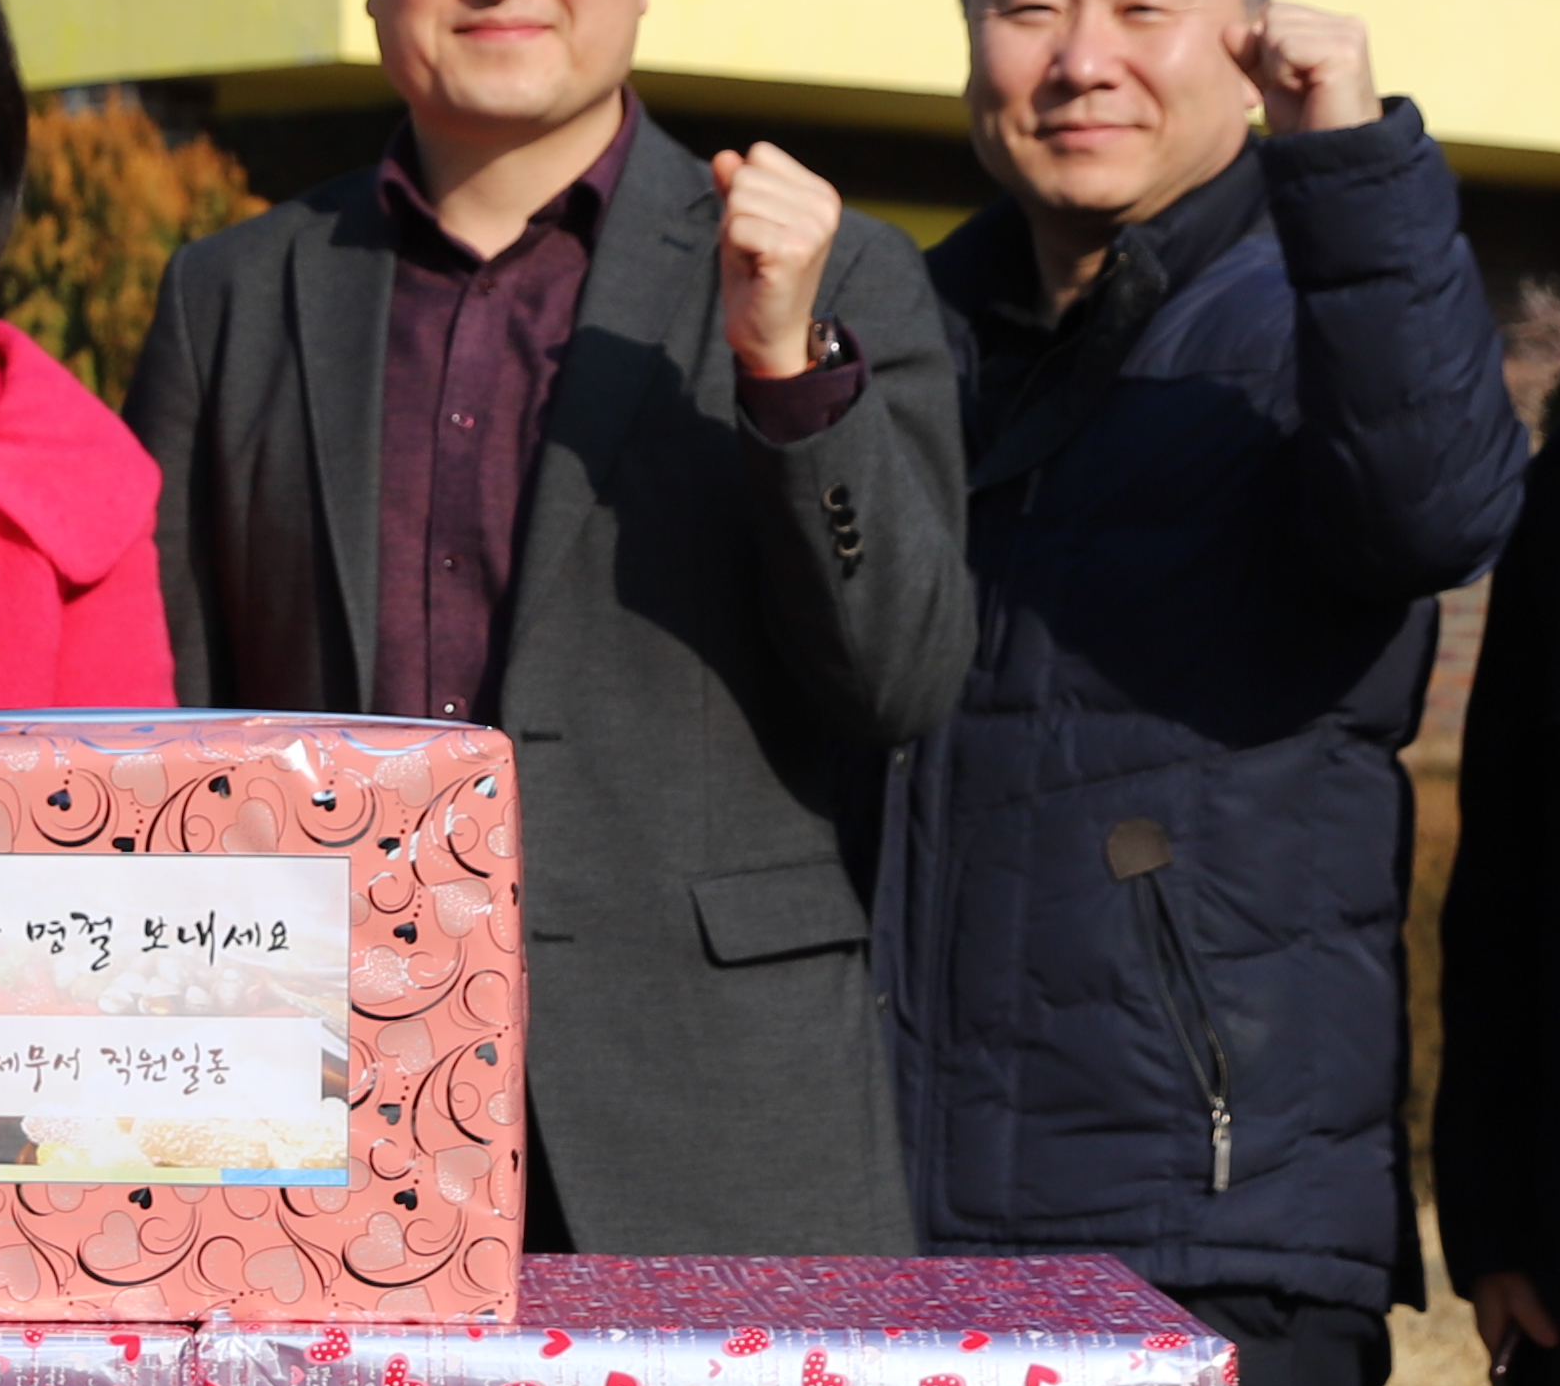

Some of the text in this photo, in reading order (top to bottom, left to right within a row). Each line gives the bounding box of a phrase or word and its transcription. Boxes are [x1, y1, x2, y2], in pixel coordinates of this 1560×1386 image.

[26, 912, 113, 972] 명절
[142, 911, 288, 964] 보내세요
[100, 1044, 229, 1095] 직원일동
